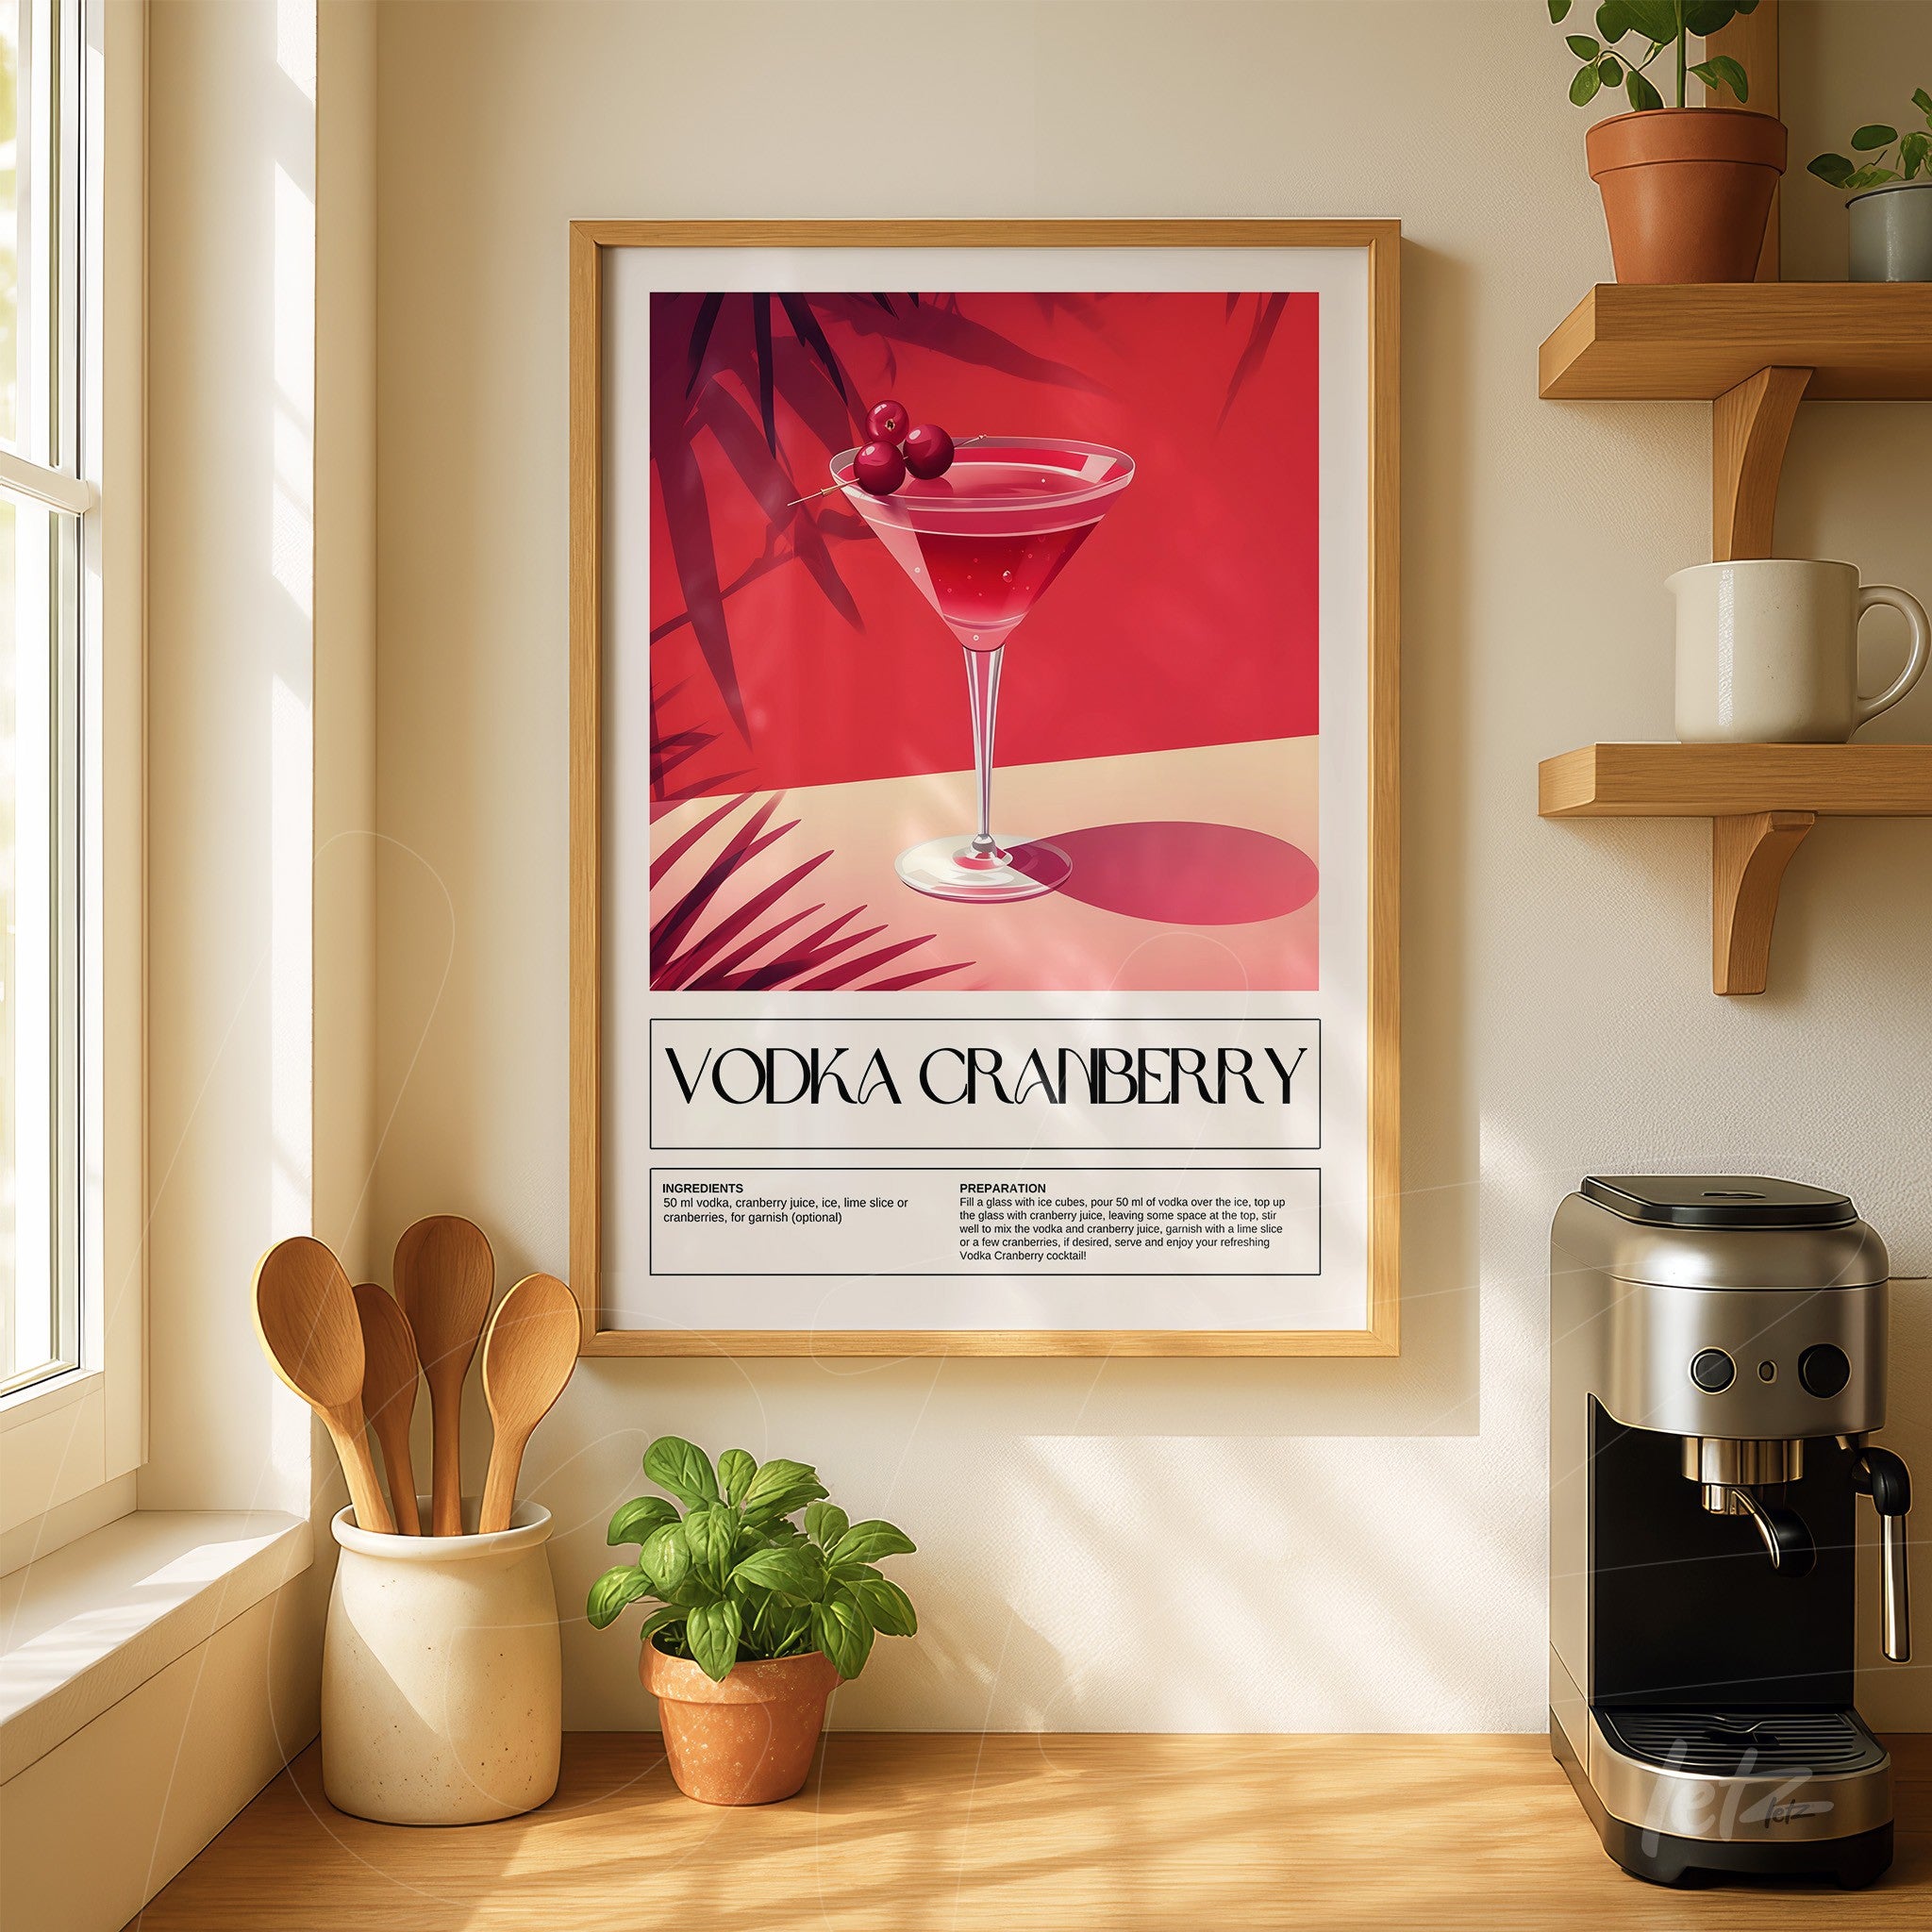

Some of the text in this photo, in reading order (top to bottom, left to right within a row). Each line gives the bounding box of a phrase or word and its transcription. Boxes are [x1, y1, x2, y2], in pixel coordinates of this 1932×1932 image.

[665, 1047, 1307, 1106] VODKA CRANBERRY
[662, 1183, 743, 1193] INGREDIENTS
[959, 1183, 1046, 1193] PREPARATION
[663, 1197, 908, 1210] 50 ml vodka, cranberry juice, ice, lime slice or
[959, 1197, 974, 1207] Fill
[986, 1197, 1012, 1208] glass
[1014, 1197, 1035, 1207] with
[1038, 1197, 1052, 1207] ice
[1055, 1197, 1088, 1208] cubes,
[1091, 1199, 1113, 1208] pour
[1116, 1197, 1129, 1207] 50
[1131, 1197, 1143, 1207] ml
[1146, 1197, 1156, 1207] of
[1158, 1197, 1189, 1207] vodka
[1215, 1197, 1231, 1207] the
[1234, 1197, 1251, 1208] ice,
[1254, 1198, 1270, 1208] top
[1273, 1199, 1286, 1208] up
[663, 1211, 842, 1225] cranberries, for garnish (optional)
[959, 1210, 975, 1220] the
[978, 1210, 1005, 1223] glass
[1007, 1210, 1027, 1220] with
[1029, 1210, 1077, 1223] cranberry
[1079, 1210, 1106, 1223] juice,
[1108, 1210, 1144, 1223] leaving
[1176, 1212, 1207, 1222] space
[1209, 1211, 1219, 1220] at
[1222, 1210, 1238, 1220] the
[1240, 1211, 1258, 1222] top,
[1261, 1210, 1276, 1220] stir
[959, 1224, 979, 1234] well
[982, 1224, 991, 1234] to
[994, 1224, 1011, 1233] mix
[1014, 1224, 1030, 1234] the
[1032, 1224, 1063, 1234] vodka
[1065, 1224, 1084, 1234] and
[1087, 1224, 1135, 1236] cranberry
[1136, 1224, 1162, 1236] juice,
[1165, 1224, 1202, 1236] garnish
[1205, 1224, 1225, 1233] with
[1237, 1224, 1257, 1233] lime
[1260, 1224, 1283, 1234] slice
[959, 1237, 1270, 1249] or a few cranberries, if desired, serve and enjoy your refreshing
[959, 1250, 1086, 1262] Vodka Cranberry cocktail!
